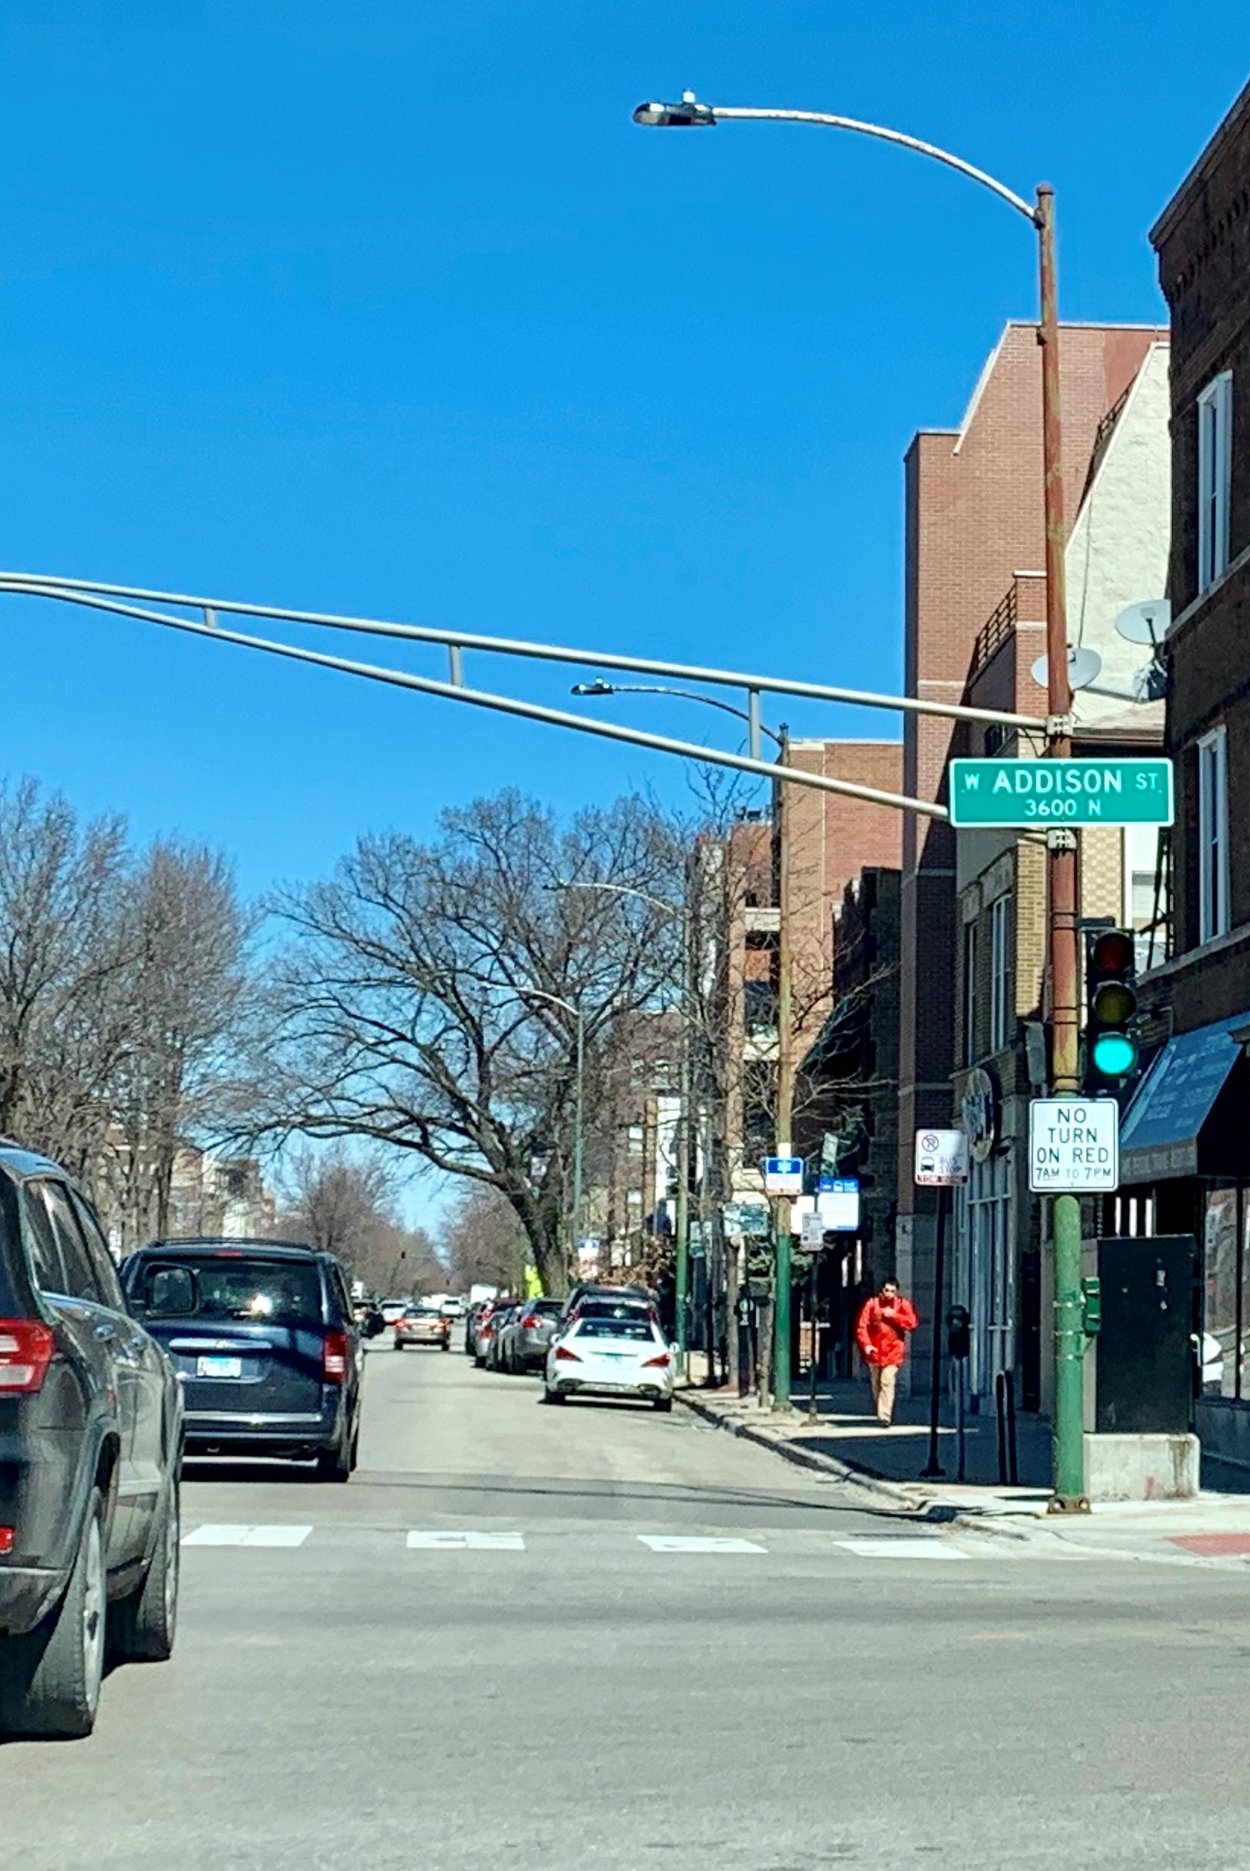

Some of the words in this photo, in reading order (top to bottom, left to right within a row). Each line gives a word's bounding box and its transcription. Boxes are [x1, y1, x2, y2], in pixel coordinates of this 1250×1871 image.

[963, 772, 980, 791] W
[992, 768, 1122, 794] ADDISON
[1136, 772, 1159, 791] ST
[1024, 798, 1077, 817] 3600
[1088, 798, 1102, 817] N
[1057, 1107, 1087, 1124] NO
[1047, 1127, 1097, 1144] TURN
[1036, 1146, 1060, 1164] ON
[1072, 1146, 1109, 1164] RED
[1035, 1167, 1060, 1181] 7AM
[1065, 1168, 1080, 1180] TO
[1084, 1167, 1112, 1181] 7PM
